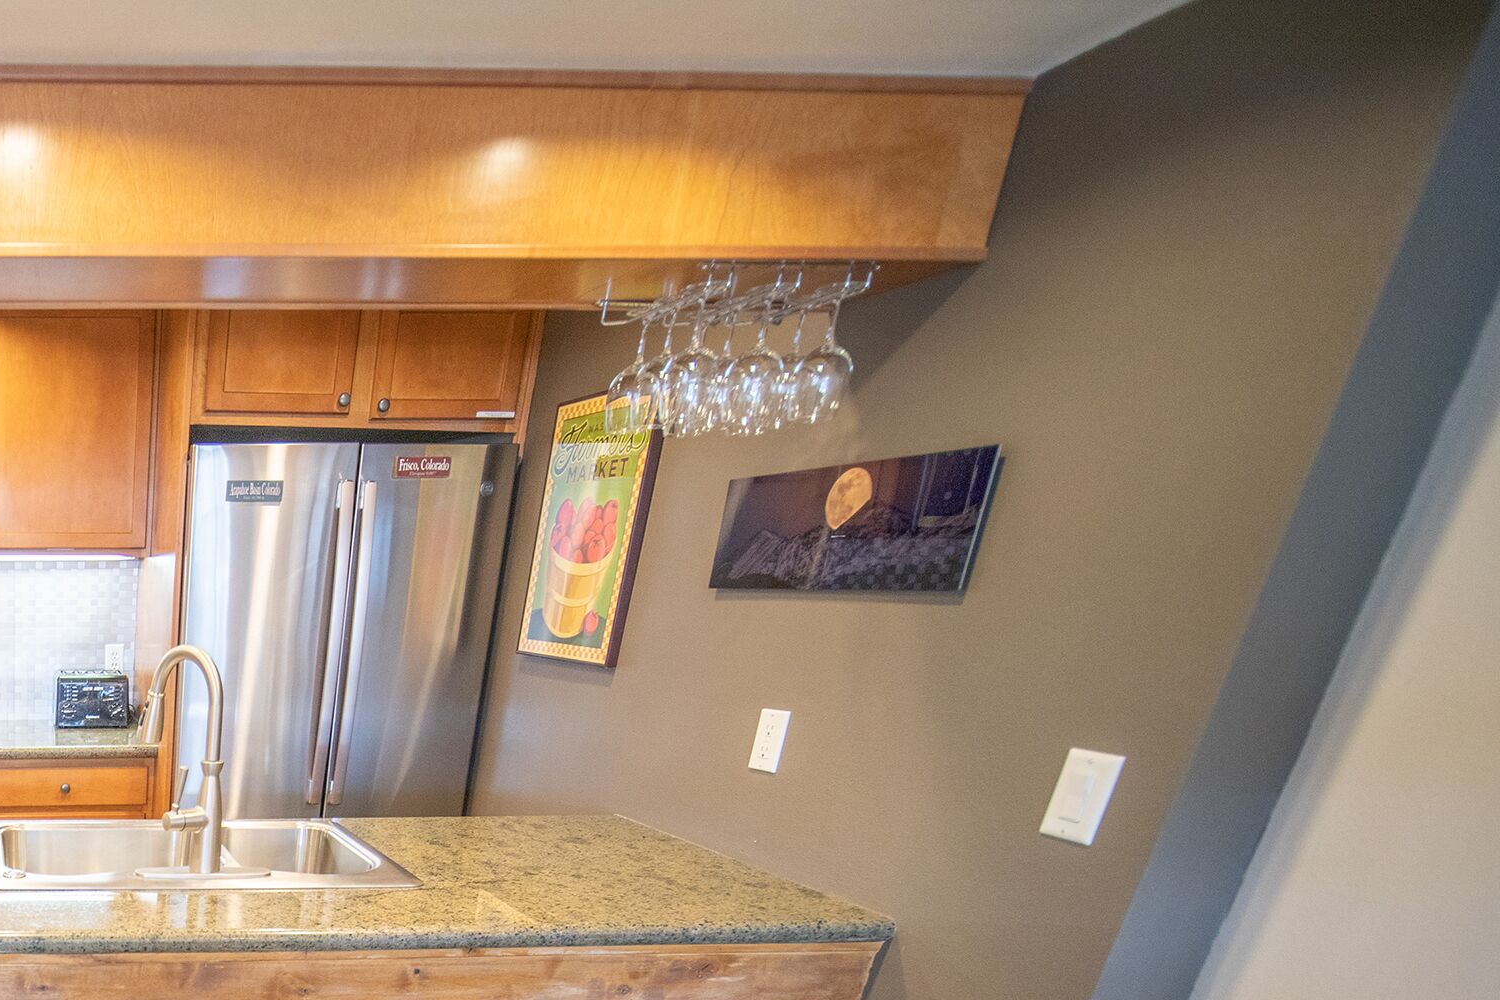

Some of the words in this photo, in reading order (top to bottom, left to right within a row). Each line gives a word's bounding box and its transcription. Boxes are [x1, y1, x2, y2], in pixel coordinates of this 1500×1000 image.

[399, 458, 420, 471] Frisco,
[420, 458, 450, 471] Colorado
[566, 457, 629, 483] MARKET
